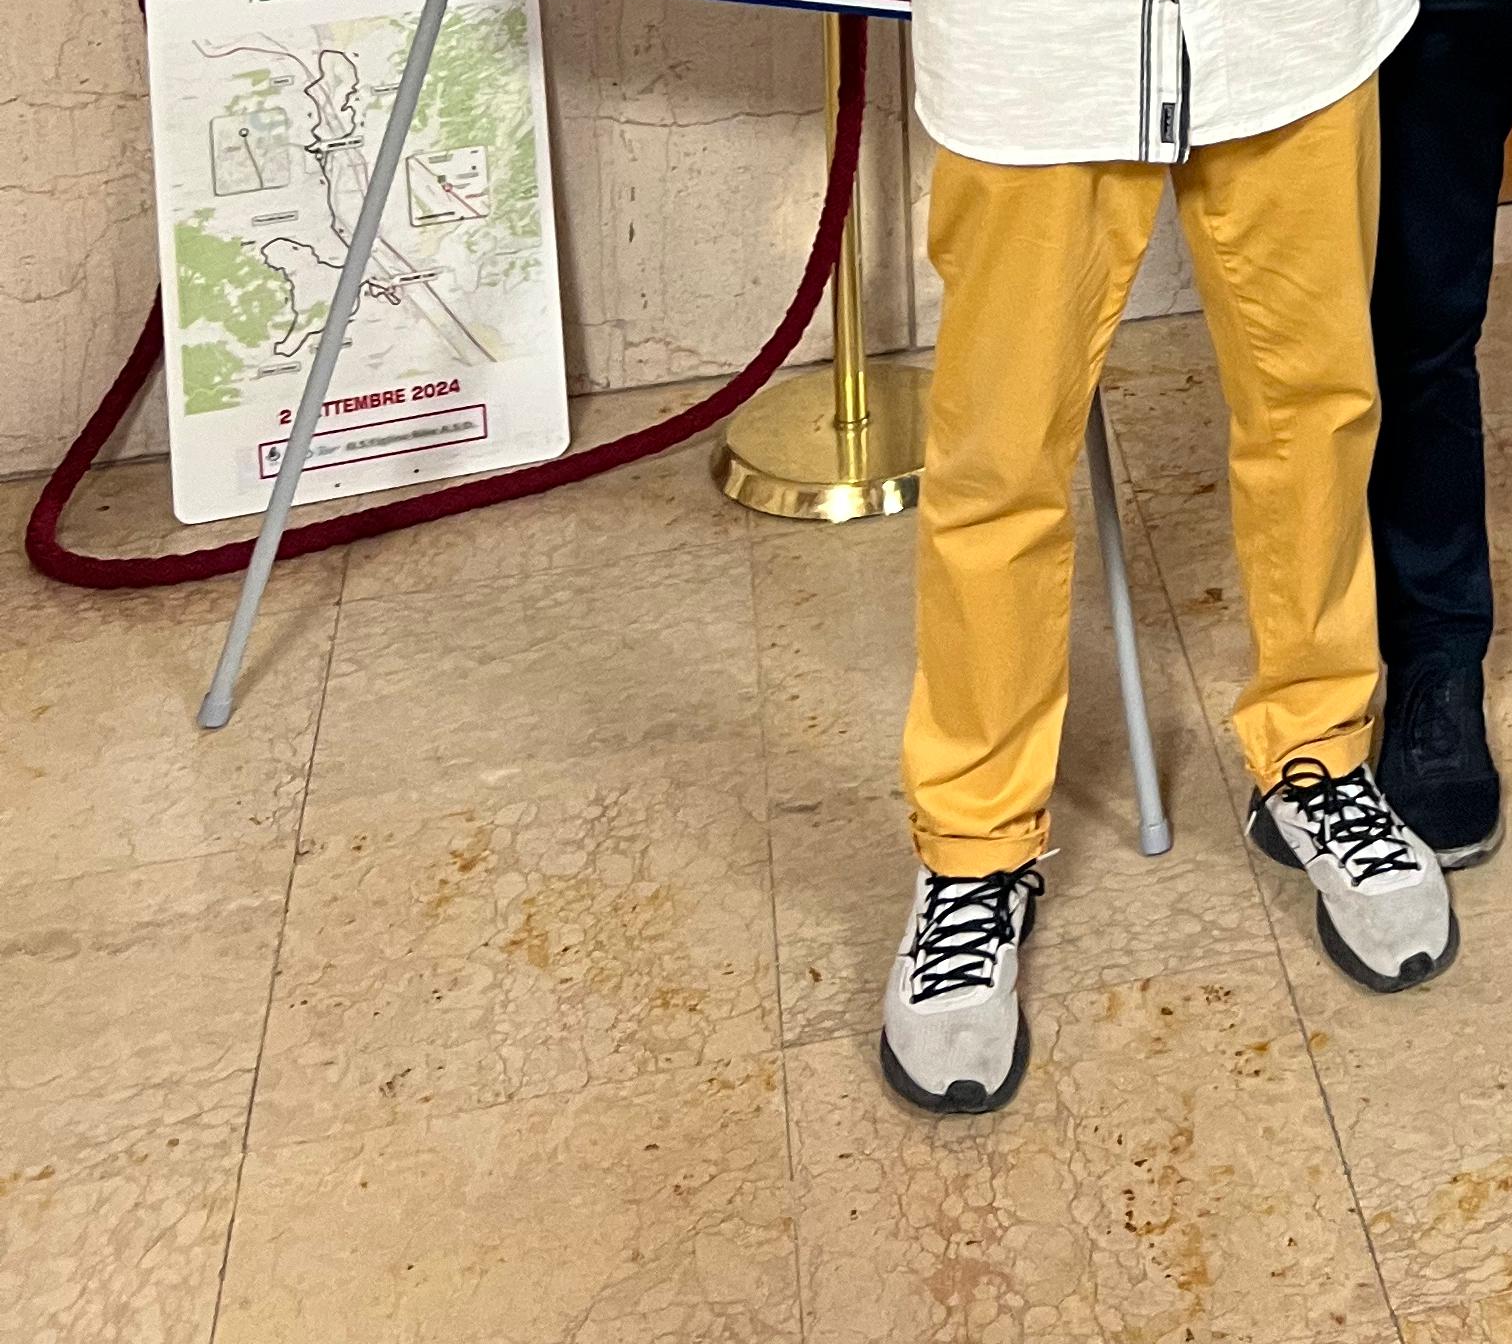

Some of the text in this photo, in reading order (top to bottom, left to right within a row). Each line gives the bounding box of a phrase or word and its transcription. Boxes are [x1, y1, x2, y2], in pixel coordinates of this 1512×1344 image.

[279, 379, 461, 425] 2 TTEMBRE 2024
